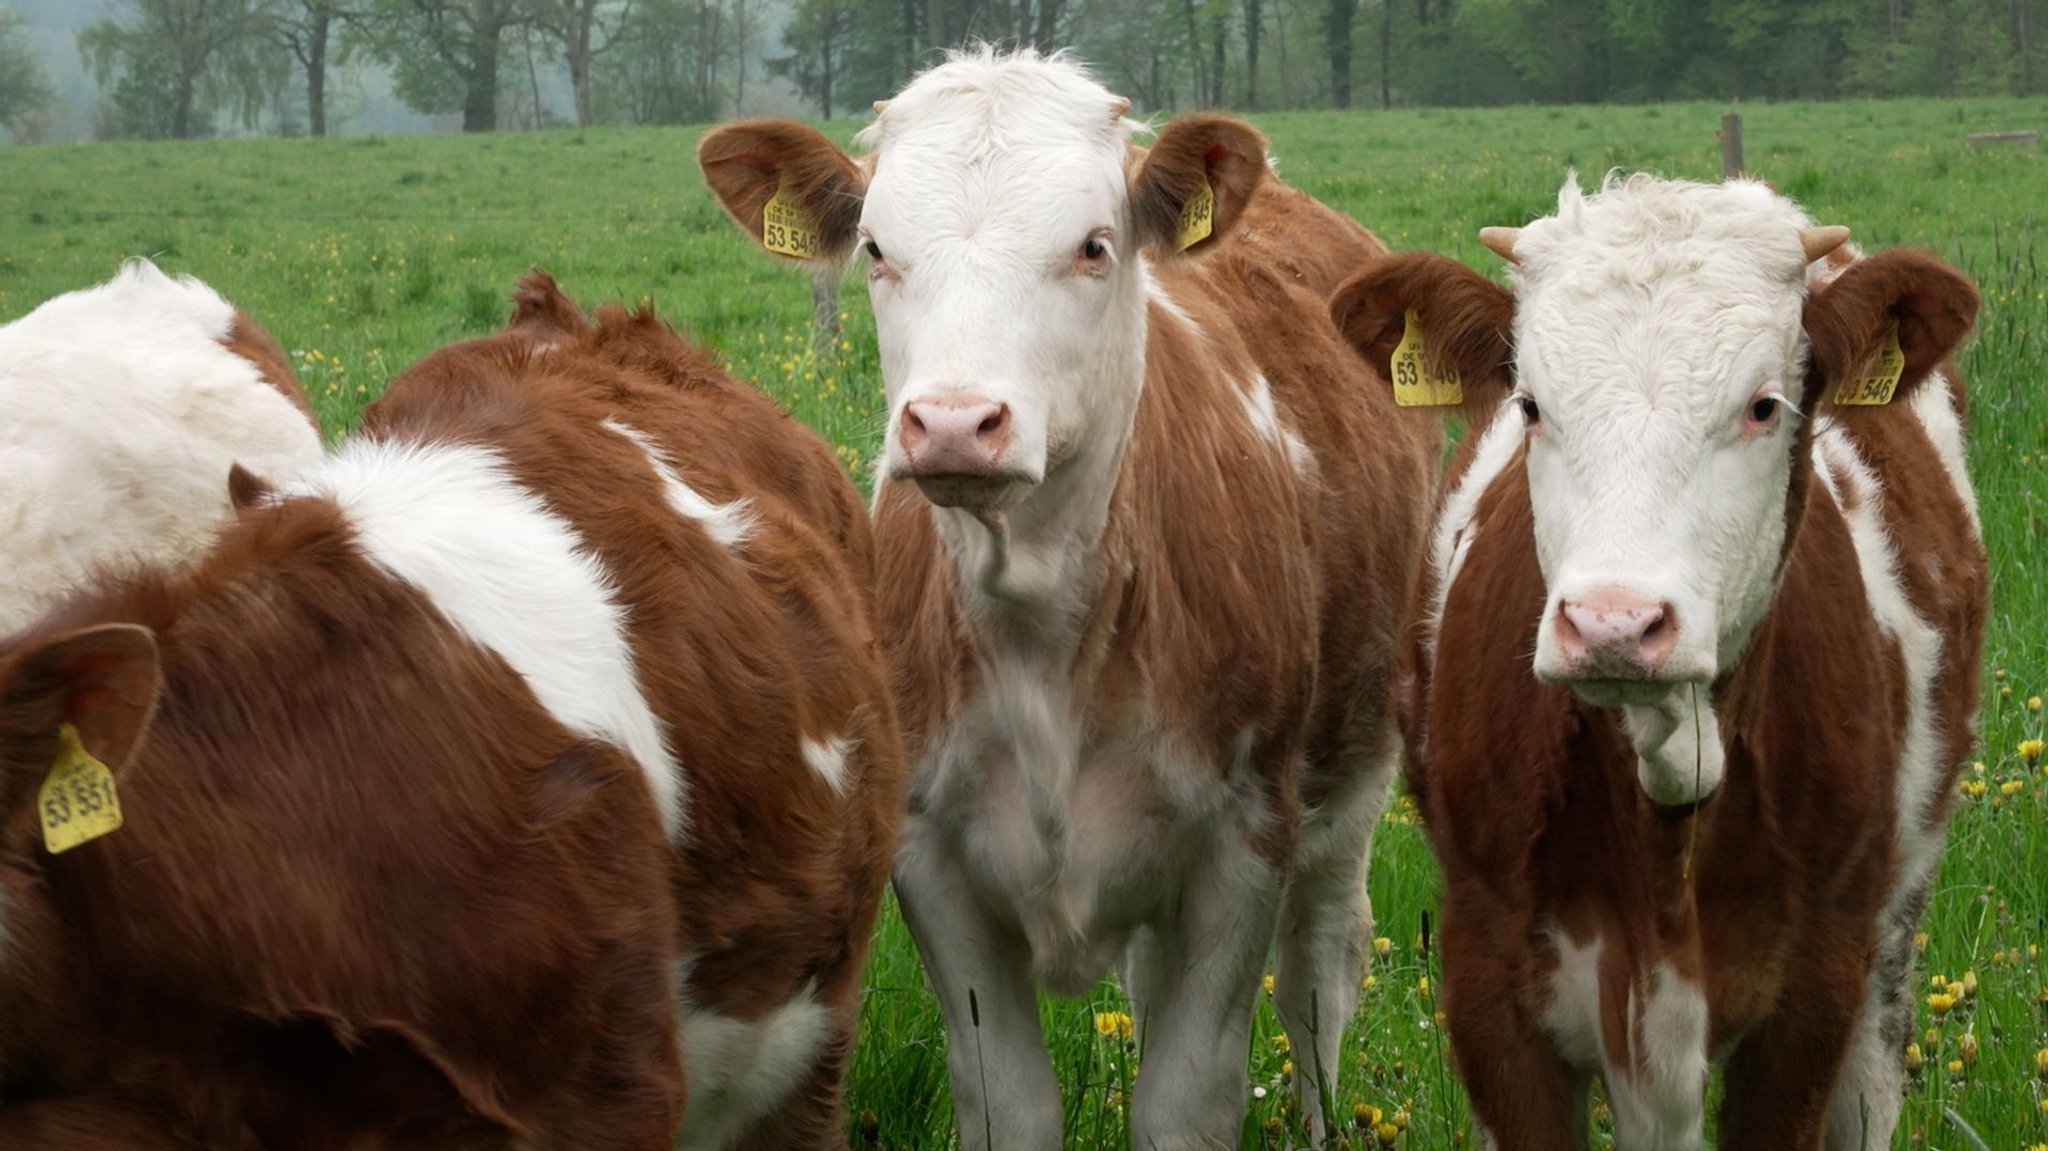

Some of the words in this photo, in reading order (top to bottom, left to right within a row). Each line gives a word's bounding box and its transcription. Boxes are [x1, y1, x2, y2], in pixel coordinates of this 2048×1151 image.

[767, 224, 786, 248] 53
[1397, 361, 1418, 386] 53
[1424, 361, 1457, 385] 46
[1861, 378, 1893, 401] 546
[45, 796, 72, 828] 53
